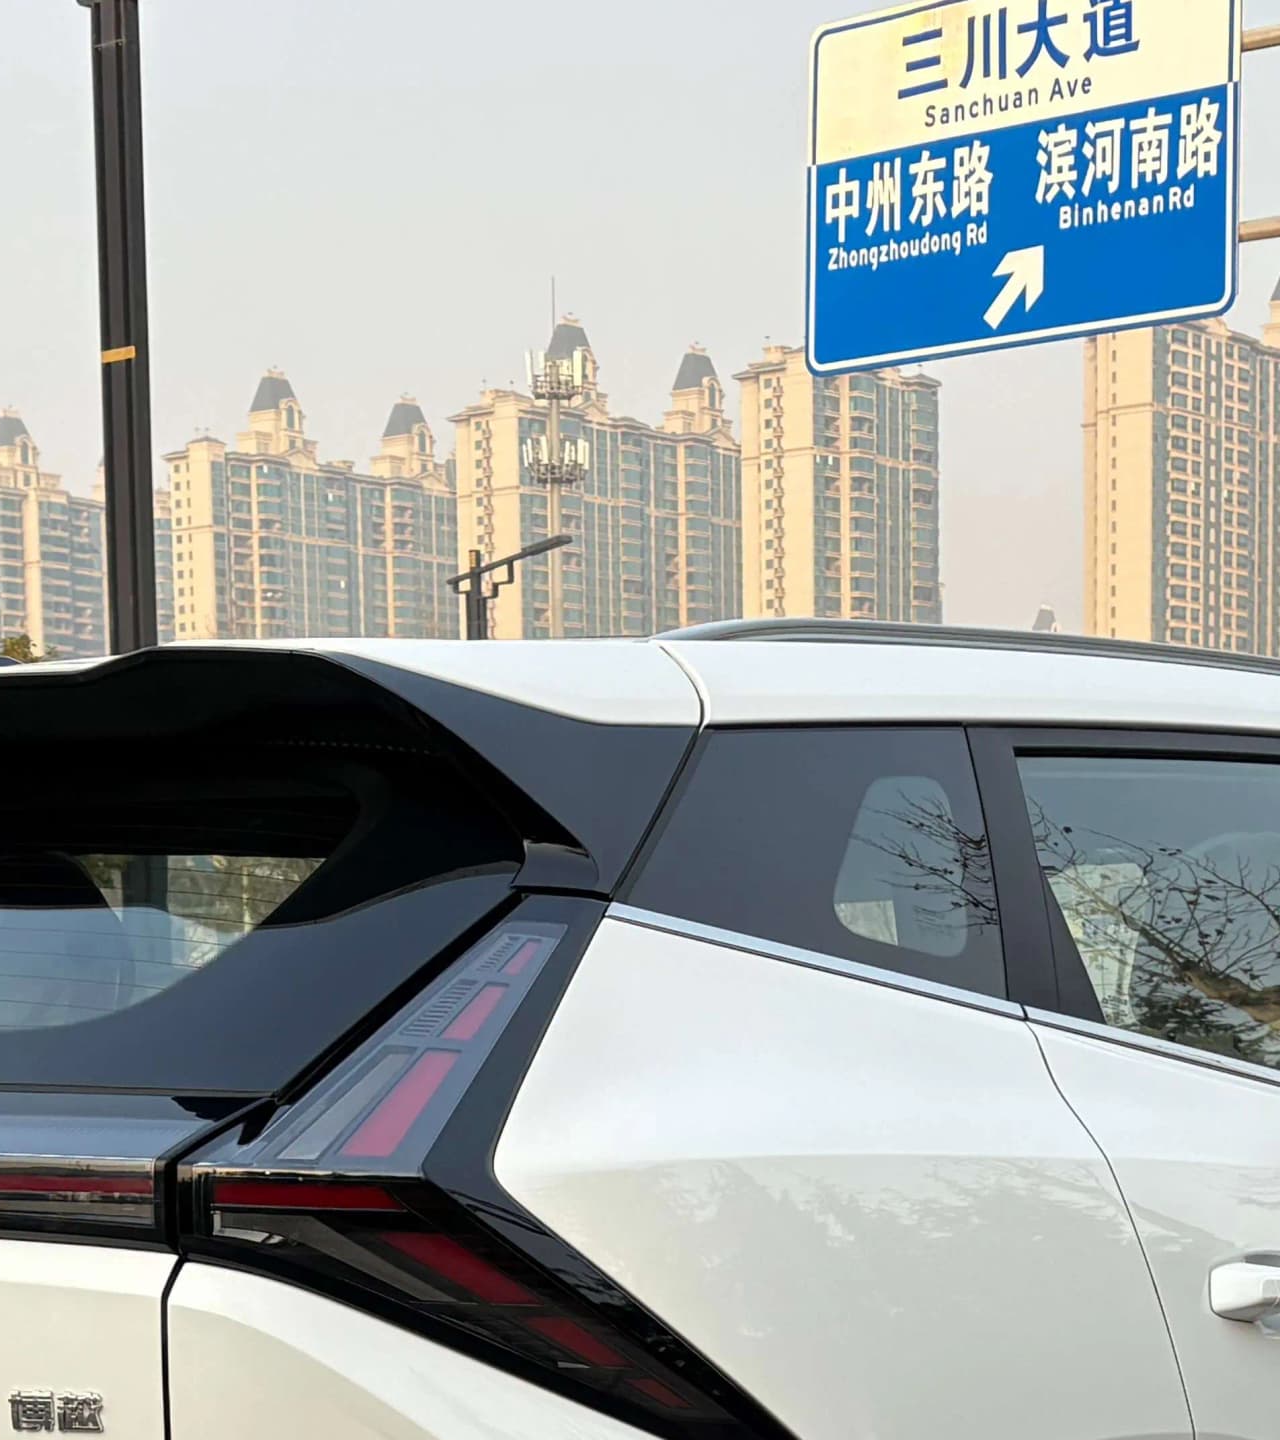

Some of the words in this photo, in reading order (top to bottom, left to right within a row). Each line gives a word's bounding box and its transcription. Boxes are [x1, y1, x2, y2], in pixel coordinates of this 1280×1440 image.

[897, 0, 1140, 100] 三川大道
[924, 85, 1039, 127] Sanchuan
[1049, 76, 1093, 102] Ave
[825, 140, 994, 243] 中州东路
[1034, 97, 1223, 204] 滨河南路
[1059, 195, 1165, 230] Binhenan
[1169, 183, 1195, 209] Rd
[827, 231, 962, 271] Zhongzhoudong
[967, 221, 988, 247] Rd
